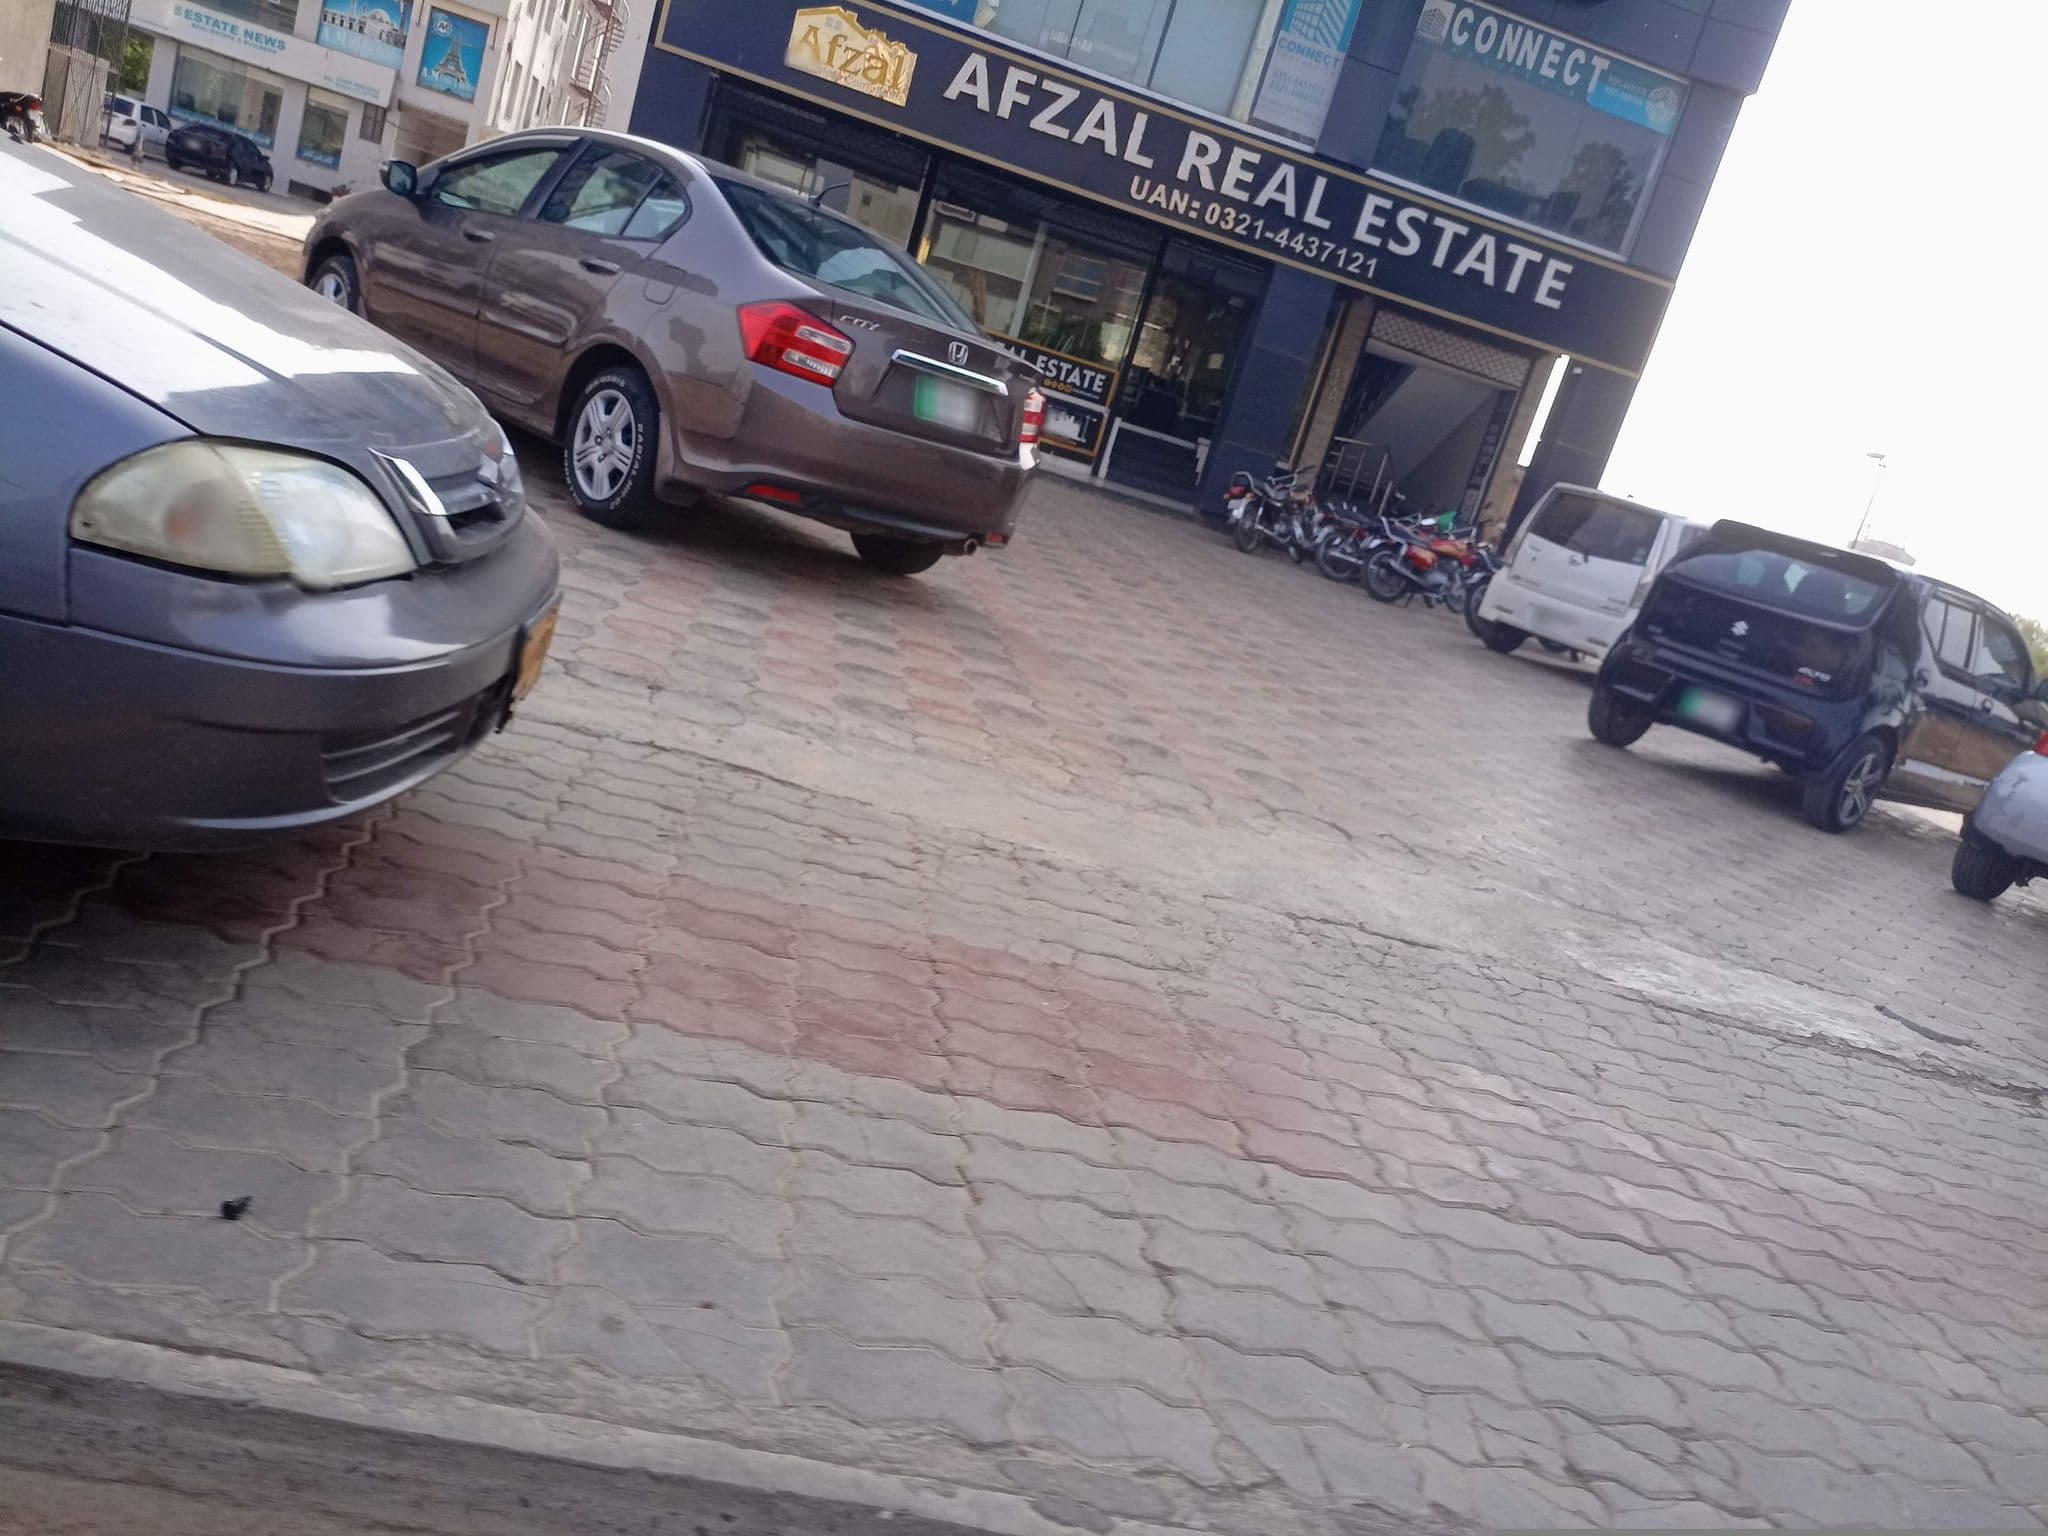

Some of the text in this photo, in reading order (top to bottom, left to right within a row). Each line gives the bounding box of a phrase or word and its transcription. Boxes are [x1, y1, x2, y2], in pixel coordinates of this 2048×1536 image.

[184, 9, 240, 36] ESTATE
[244, 28, 286, 50] NEWS
[800, 25, 903, 91] Afzal
[1278, 37, 1340, 67] CONNECT
[1451, 7, 1610, 100] CONNECT
[943, 52, 1154, 169] AFZAL
[1176, 129, 1332, 230] REAL
[1352, 193, 1575, 310] ESTATE
[1129, 175, 1379, 279] UAN: 0321-4437121
[1036, 354, 1107, 393] ESTATE
